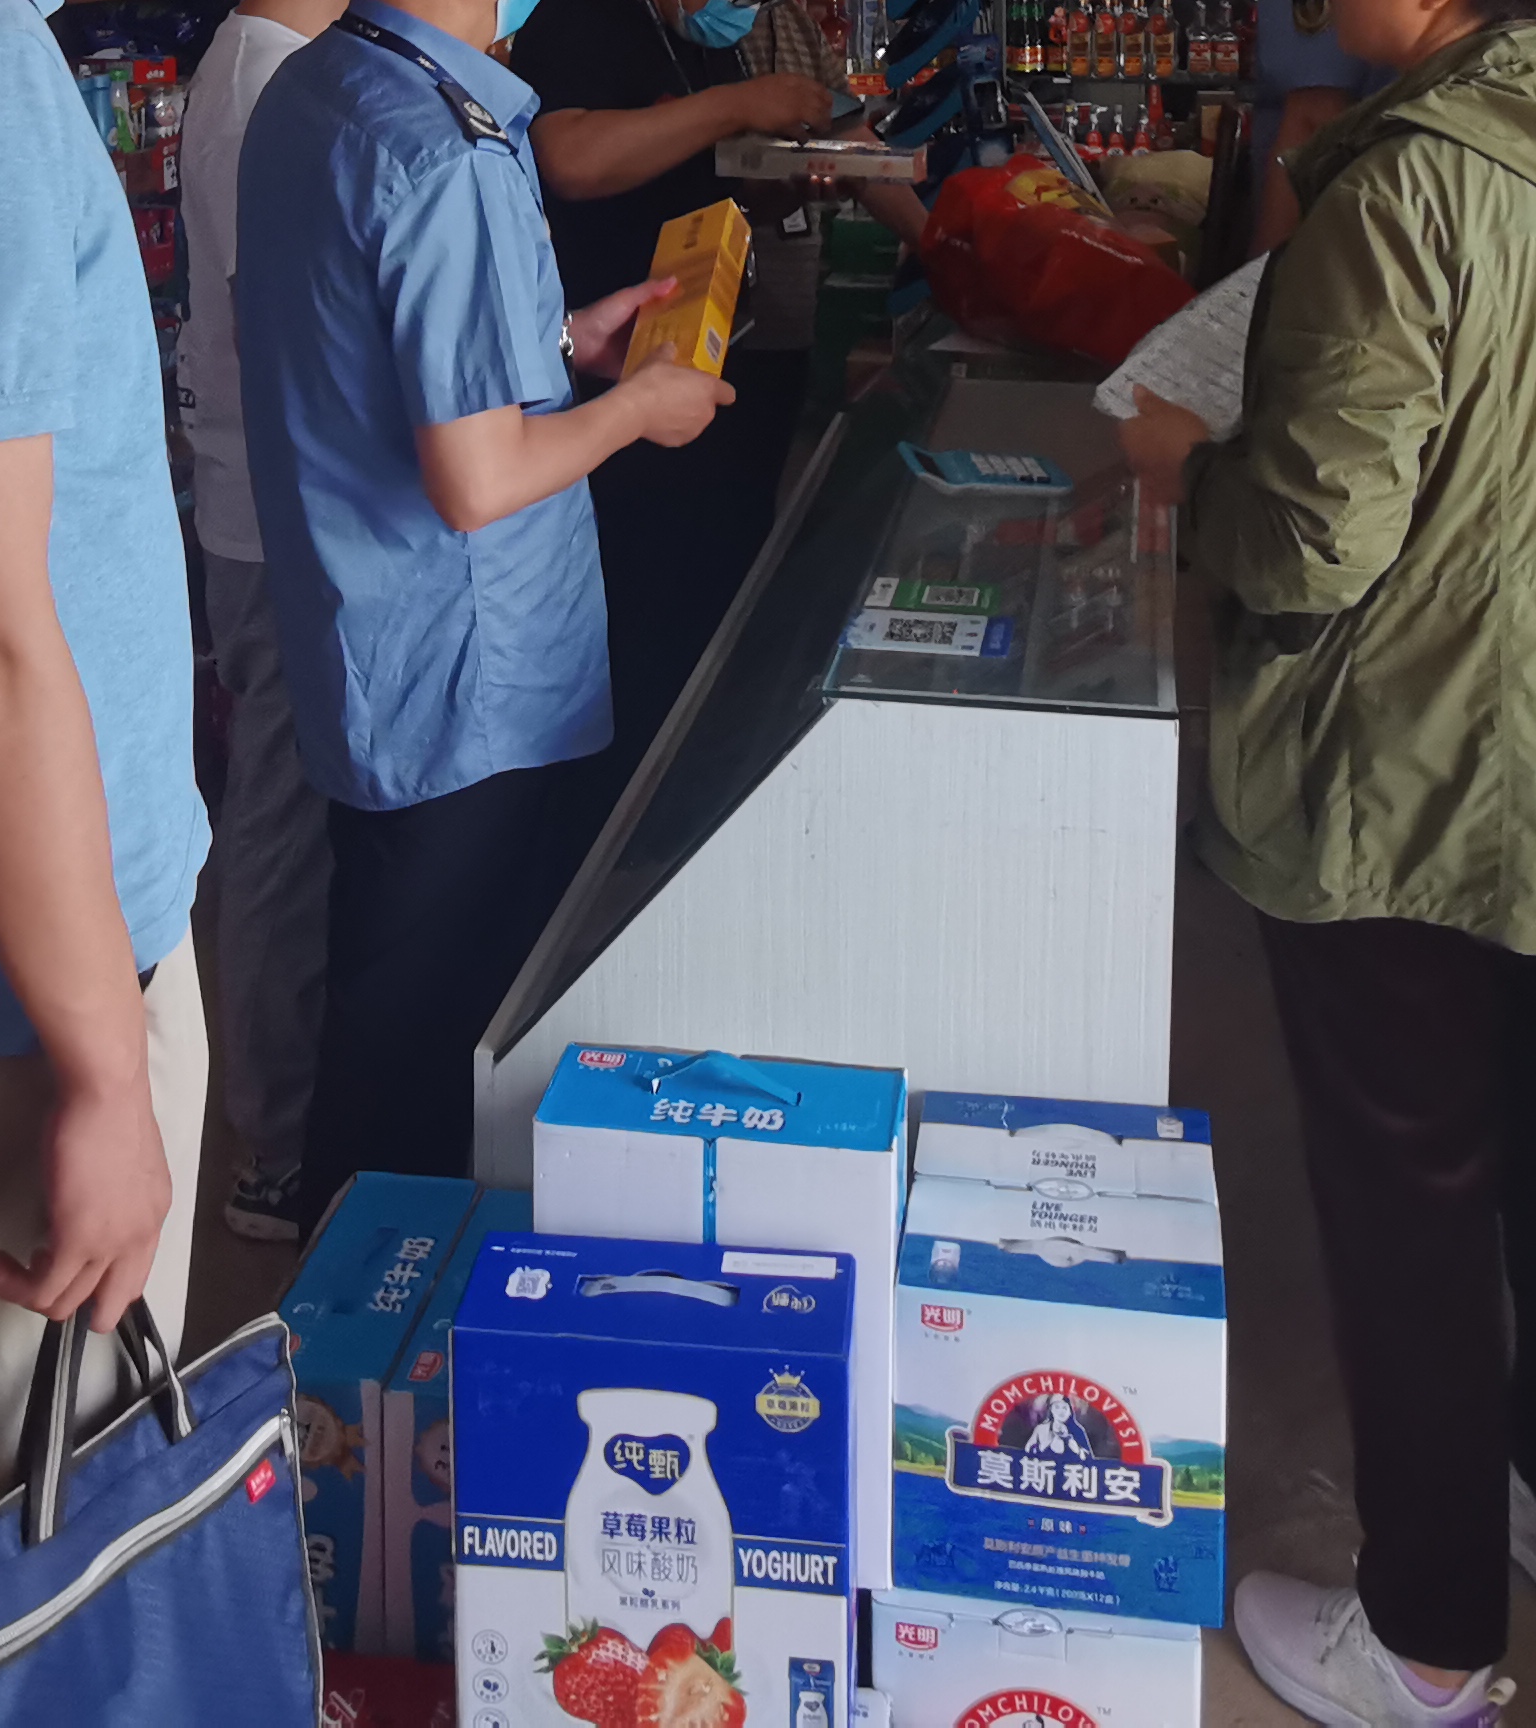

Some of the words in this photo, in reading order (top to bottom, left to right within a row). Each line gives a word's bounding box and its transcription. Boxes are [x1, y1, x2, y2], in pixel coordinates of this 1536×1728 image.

[580, 1051, 626, 1066] 光明
[650, 1099, 785, 1131] 纯牛奶
[1030, 1209, 1098, 1224] YOUNGER
[1032, 1201, 1063, 1212] LIVE
[368, 1235, 436, 1313] 纯牛奶
[923, 1307, 962, 1325] 光明
[980, 1376, 1140, 1448] MOMCHILOVTSI
[613, 1439, 681, 1481] 纯甄
[977, 1449, 1141, 1504] 莫斯利安
[464, 1525, 558, 1563] FLAVORED
[600, 1511, 698, 1546] 草莓果粒
[600, 1548, 699, 1585] 风味酸奶
[738, 1547, 838, 1586] YOGHURT
[898, 1624, 936, 1645] 光明
